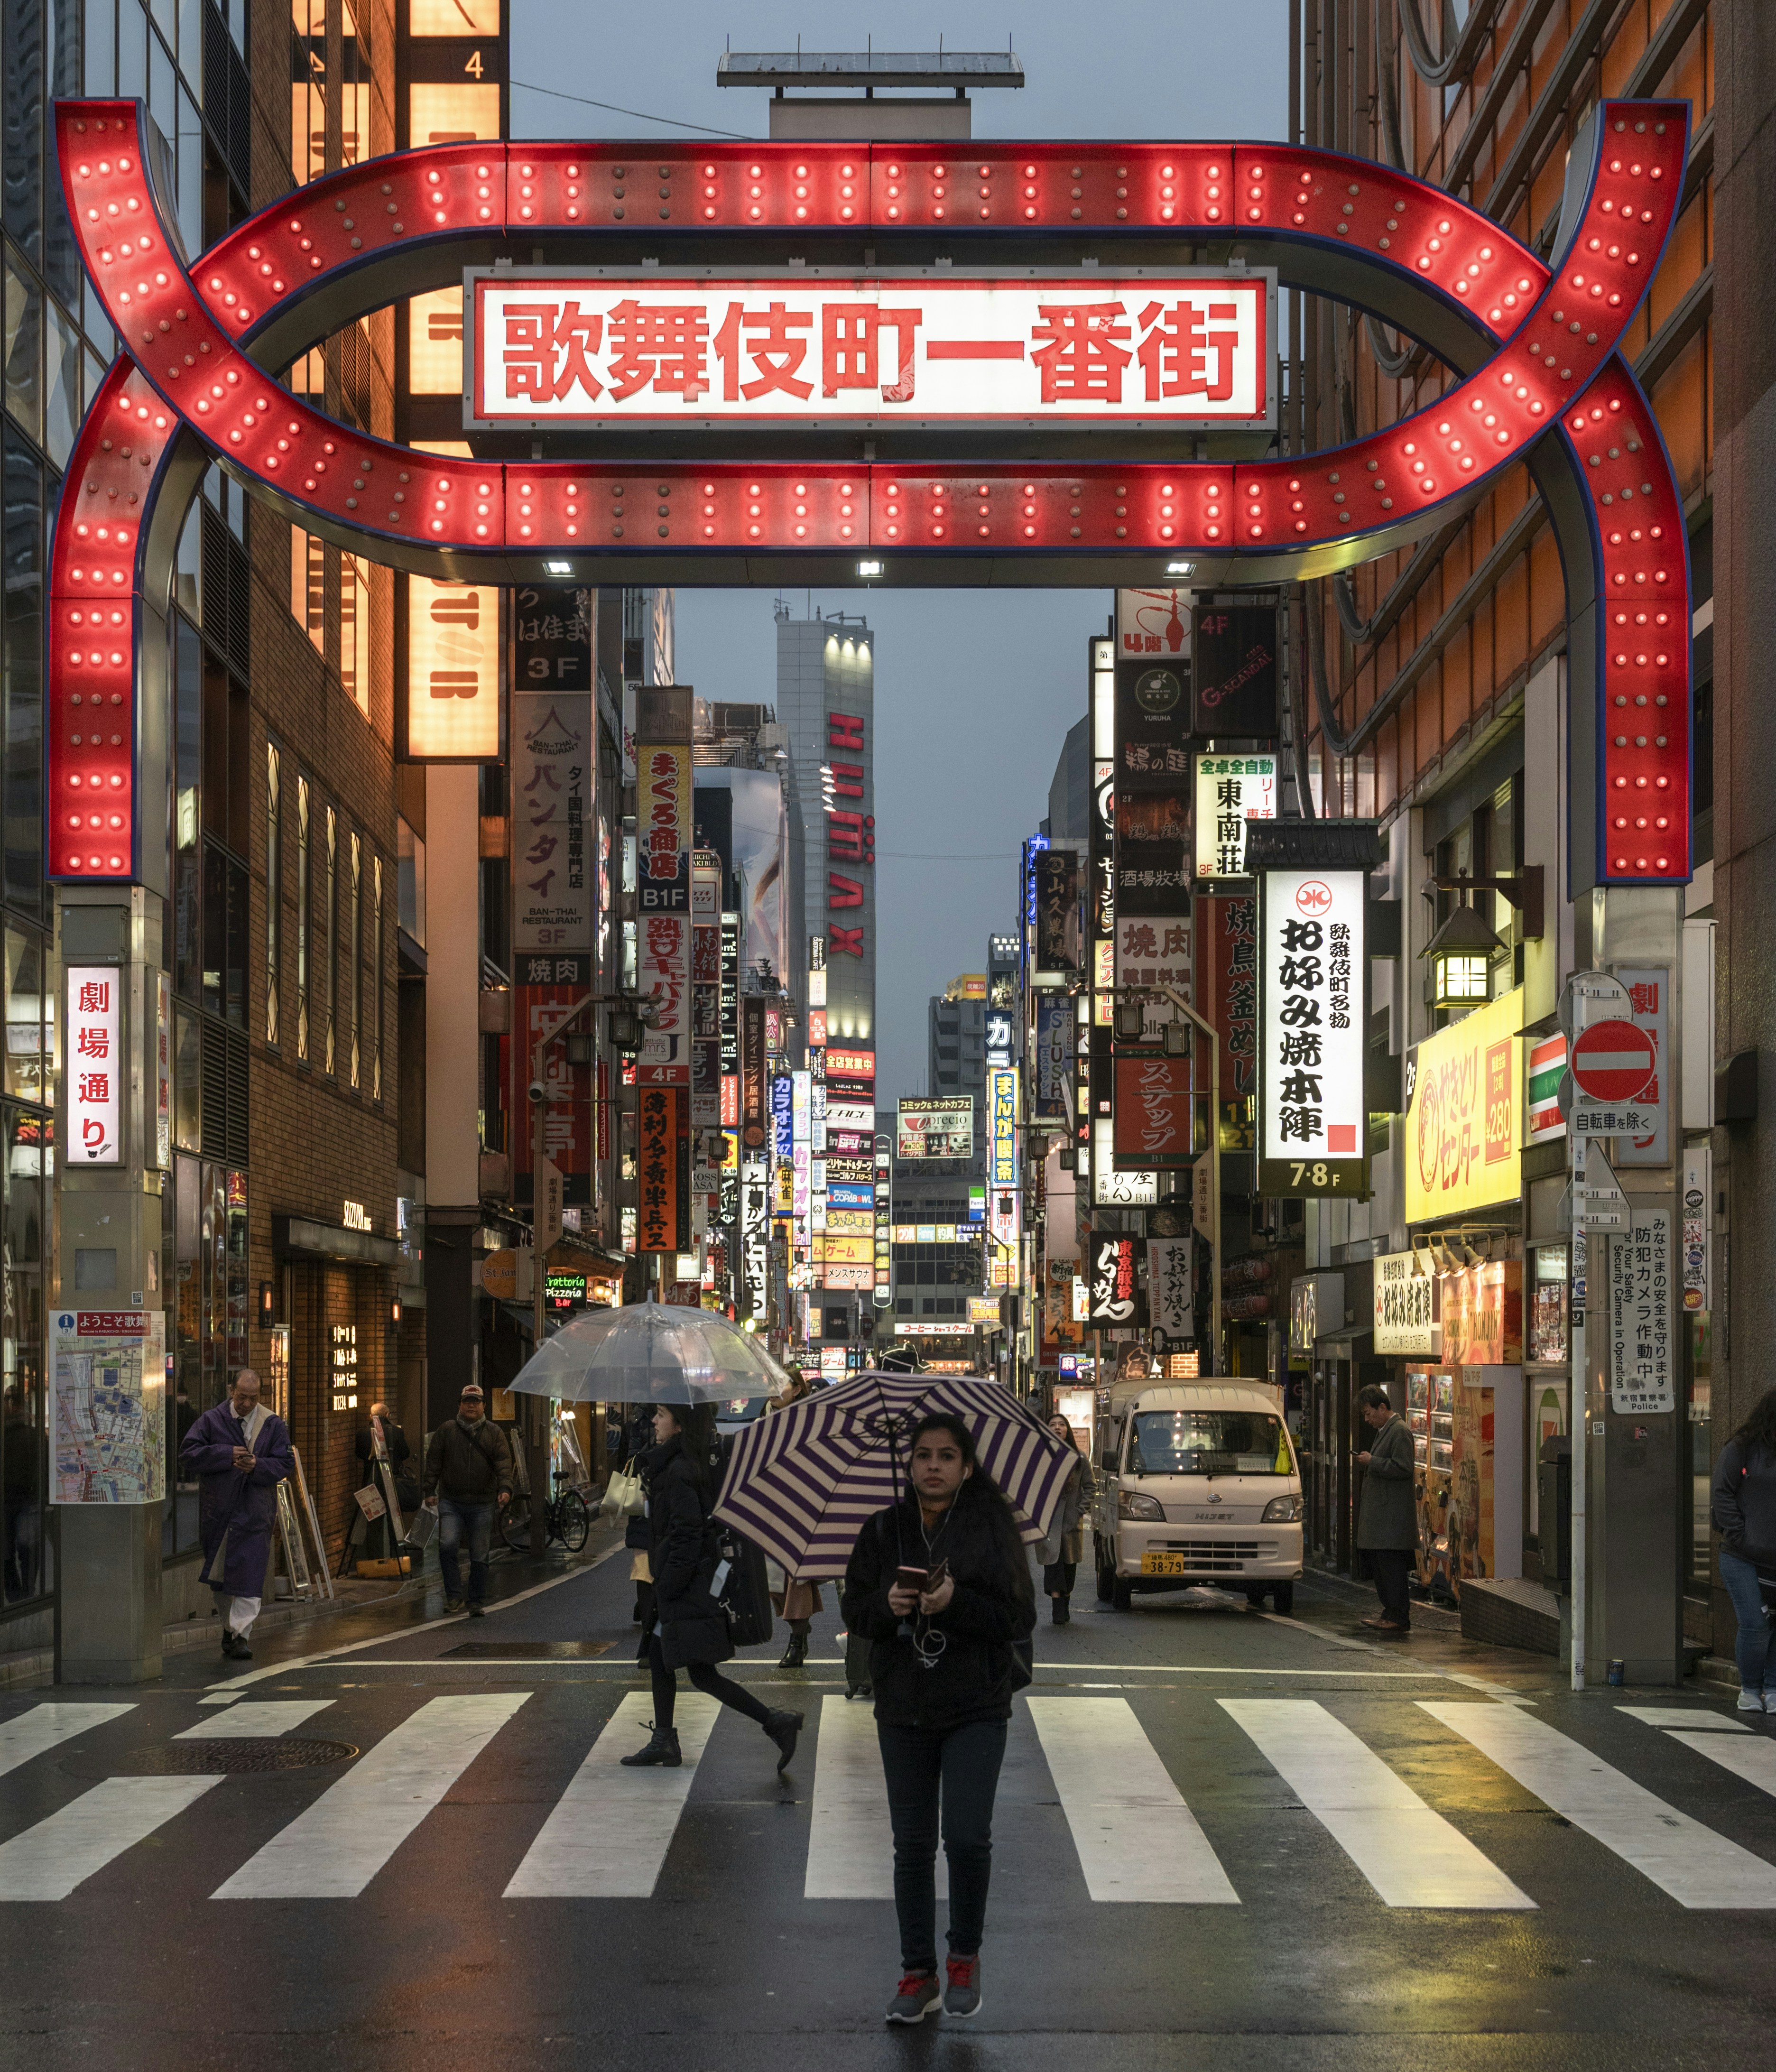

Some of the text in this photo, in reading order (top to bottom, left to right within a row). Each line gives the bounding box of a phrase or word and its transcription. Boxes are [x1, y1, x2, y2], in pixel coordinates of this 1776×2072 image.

[465, 51, 483, 78] 4
[503, 299, 1238, 403] 歌舞伎町一番街
[1200, 616, 1228, 635] 4F
[528, 657, 579, 678] 3F
[527, 743, 579, 755] RESTAURANT
[533, 740, 573, 748] BAN-THAI
[1098, 768, 1111, 776] 4F
[1200, 759, 1273, 775] 全卓全自動
[568, 766, 583, 889] タイ国料理専門店
[649, 751, 679, 879] まぐろ商店
[1216, 778, 1244, 875] 東南荘
[524, 764, 562, 898] バンタイ
[1120, 870, 1191, 887] 酒場牧場
[1200, 864, 1212, 875] 3F
[643, 889, 684, 906] B1F
[522, 916, 583, 925] RESTAURANT
[529, 908, 576, 916] BAN-THAI
[538, 929, 567, 944] 3F
[1122, 924, 1191, 958] 焼肉
[528, 959, 578, 983] 焼肉
[1329, 923, 1350, 1029] 歌舞伎町名物
[701, 986, 715, 1035] レンタル
[1044, 997, 1070, 1009] 麻雀
[1278, 918, 1324, 1143] お好み焼本陣
[77, 981, 110, 1148] 劇場通り
[651, 1067, 677, 1082] 4F
[749, 1013, 758, 1118] 個室ダイニング居酒屋
[826, 1055, 872, 1071] 全店営業中
[1406, 1061, 1416, 1096] 2F
[1439, 1045, 1479, 1123] やきとり
[774, 1077, 791, 1141] カラオケ
[826, 1109, 873, 1119] FACE
[900, 1100, 971, 1110] コミック&ネットカフェ
[1139, 1062, 1176, 1151] ステップ
[995, 1073, 1015, 1183] まんが喫茶
[1486, 1098, 1511, 1144] ¥280
[1577, 1112, 1649, 1130] 自転車を除く
[814, 1122, 822, 1148] SEGA
[1440, 1123, 1480, 1191] センター
[782, 1168, 792, 1200] 麻雀
[814, 1161, 822, 1188] SEGA
[1099, 1173, 1109, 1202] 一番街
[548, 1177, 557, 1232] 劇場通り一番街
[1135, 1193, 1156, 1203] B1F
[1199, 1168, 1208, 1223] 劇場通り一番街
[827, 1212, 872, 1227] まんが喫茶
[826, 1245, 856, 1258] ゲーム
[546, 1276, 585, 1287] rattoria
[828, 1268, 870, 1278] メンズサウナ
[1116, 1239, 1133, 1300] 東京豚骨
[1623, 1248, 1635, 1304] Your Safety
[546, 1288, 582, 1298] Pizzeria
[1163, 1245, 1190, 1328] お好み焼き
[555, 1298, 572, 1307] Bar
[1049, 1283, 1067, 1336] まっちゃん
[1152, 1282, 1161, 1322] TEPPANYAKI
[1635, 1227, 1653, 1378] 防犯カメラ作動中
[1653, 1218, 1668, 1387] みなさまの安全を守ります
[904, 1324, 932, 1332] コーヒー
[1613, 1245, 1625, 1389] Security Camera in Operation
[1172, 1341, 1193, 1353] B1F
[823, 1358, 844, 1366] ゲーム
[1620, 1394, 1667, 1403] 新宿警察署
[1150, 1562, 1182, 1572] 38-79
